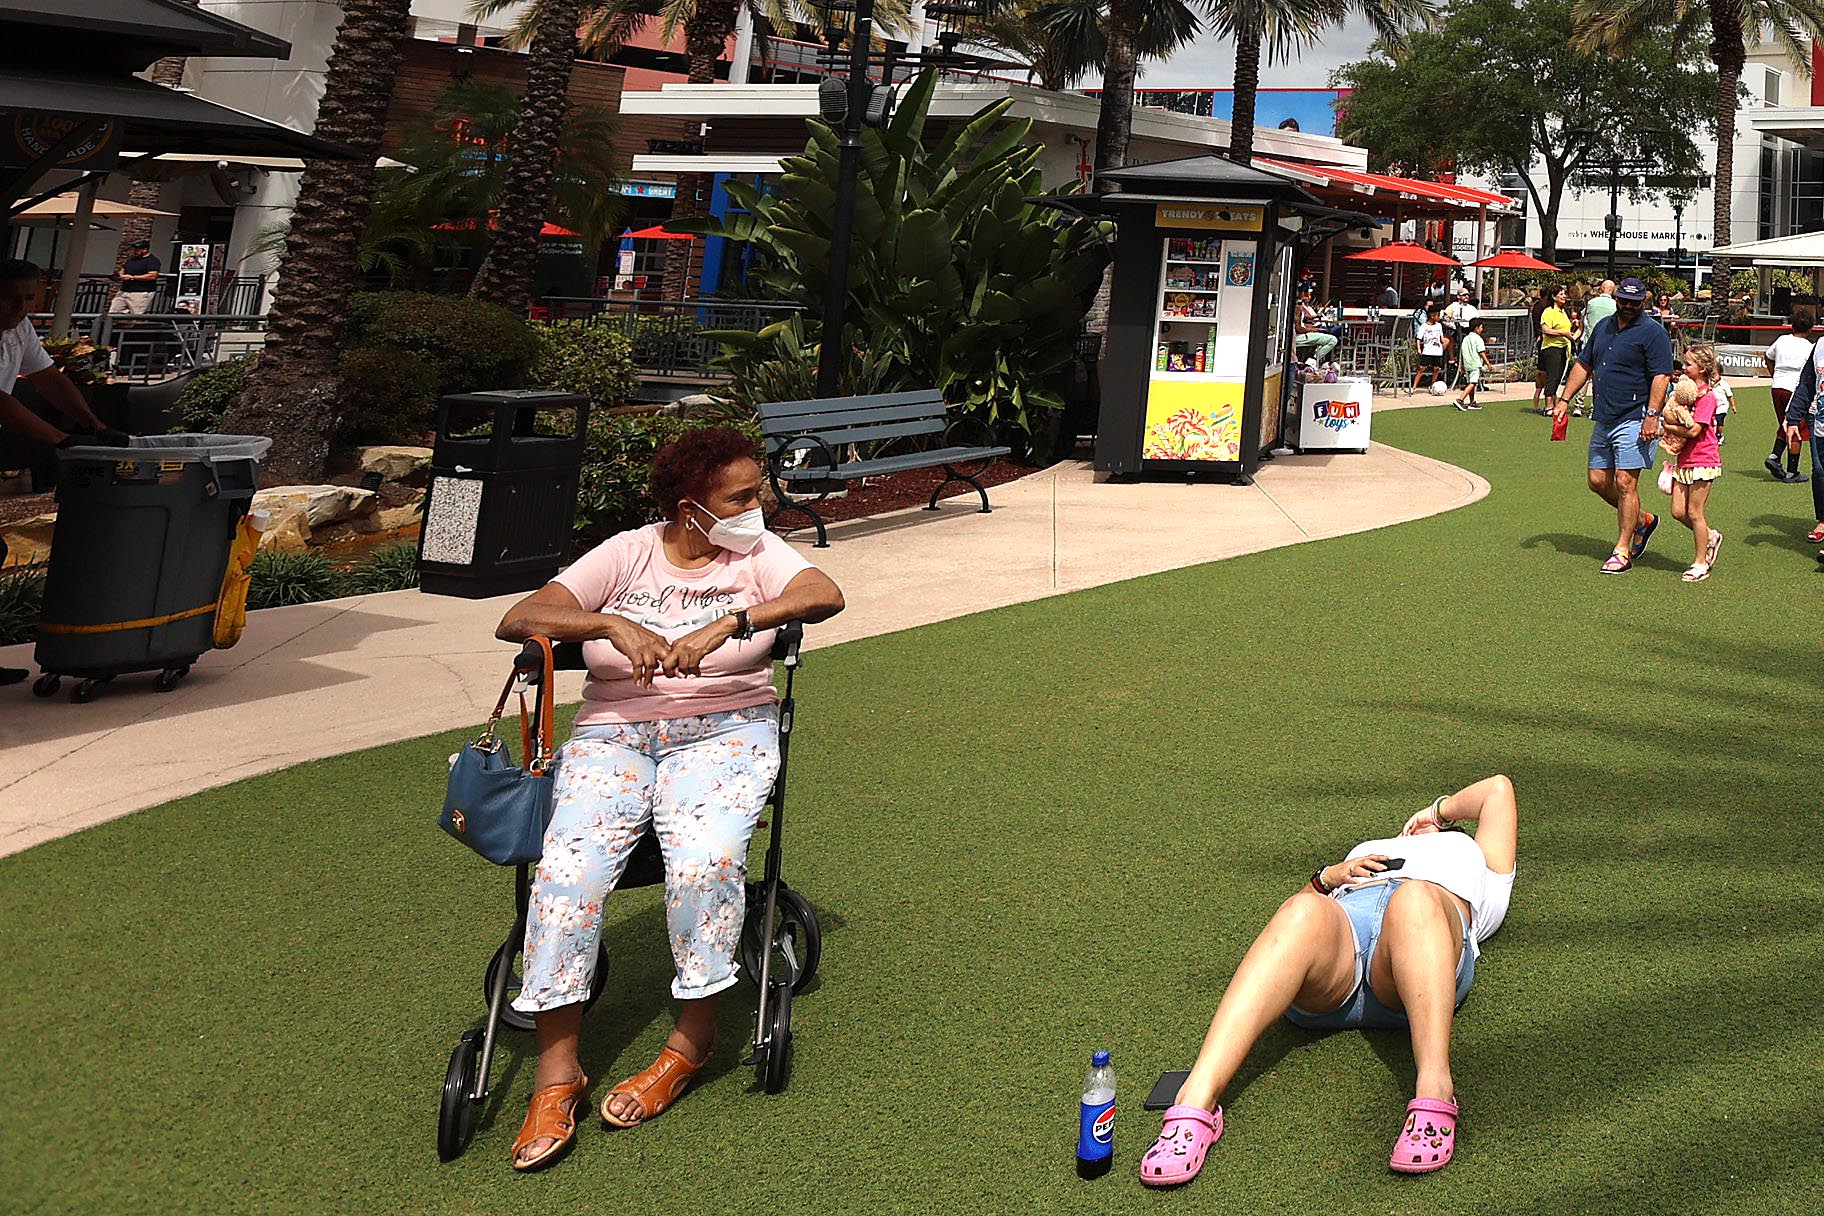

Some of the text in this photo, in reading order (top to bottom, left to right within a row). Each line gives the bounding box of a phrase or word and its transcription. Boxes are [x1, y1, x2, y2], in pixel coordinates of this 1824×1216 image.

[1161, 209, 1204, 219] TRENDY
[1590, 230, 1648, 239] WHELHOUSE
[1651, 232, 1686, 240] MARKT
[1316, 403, 1356, 417] FUN
[1324, 415, 1348, 431] toys
